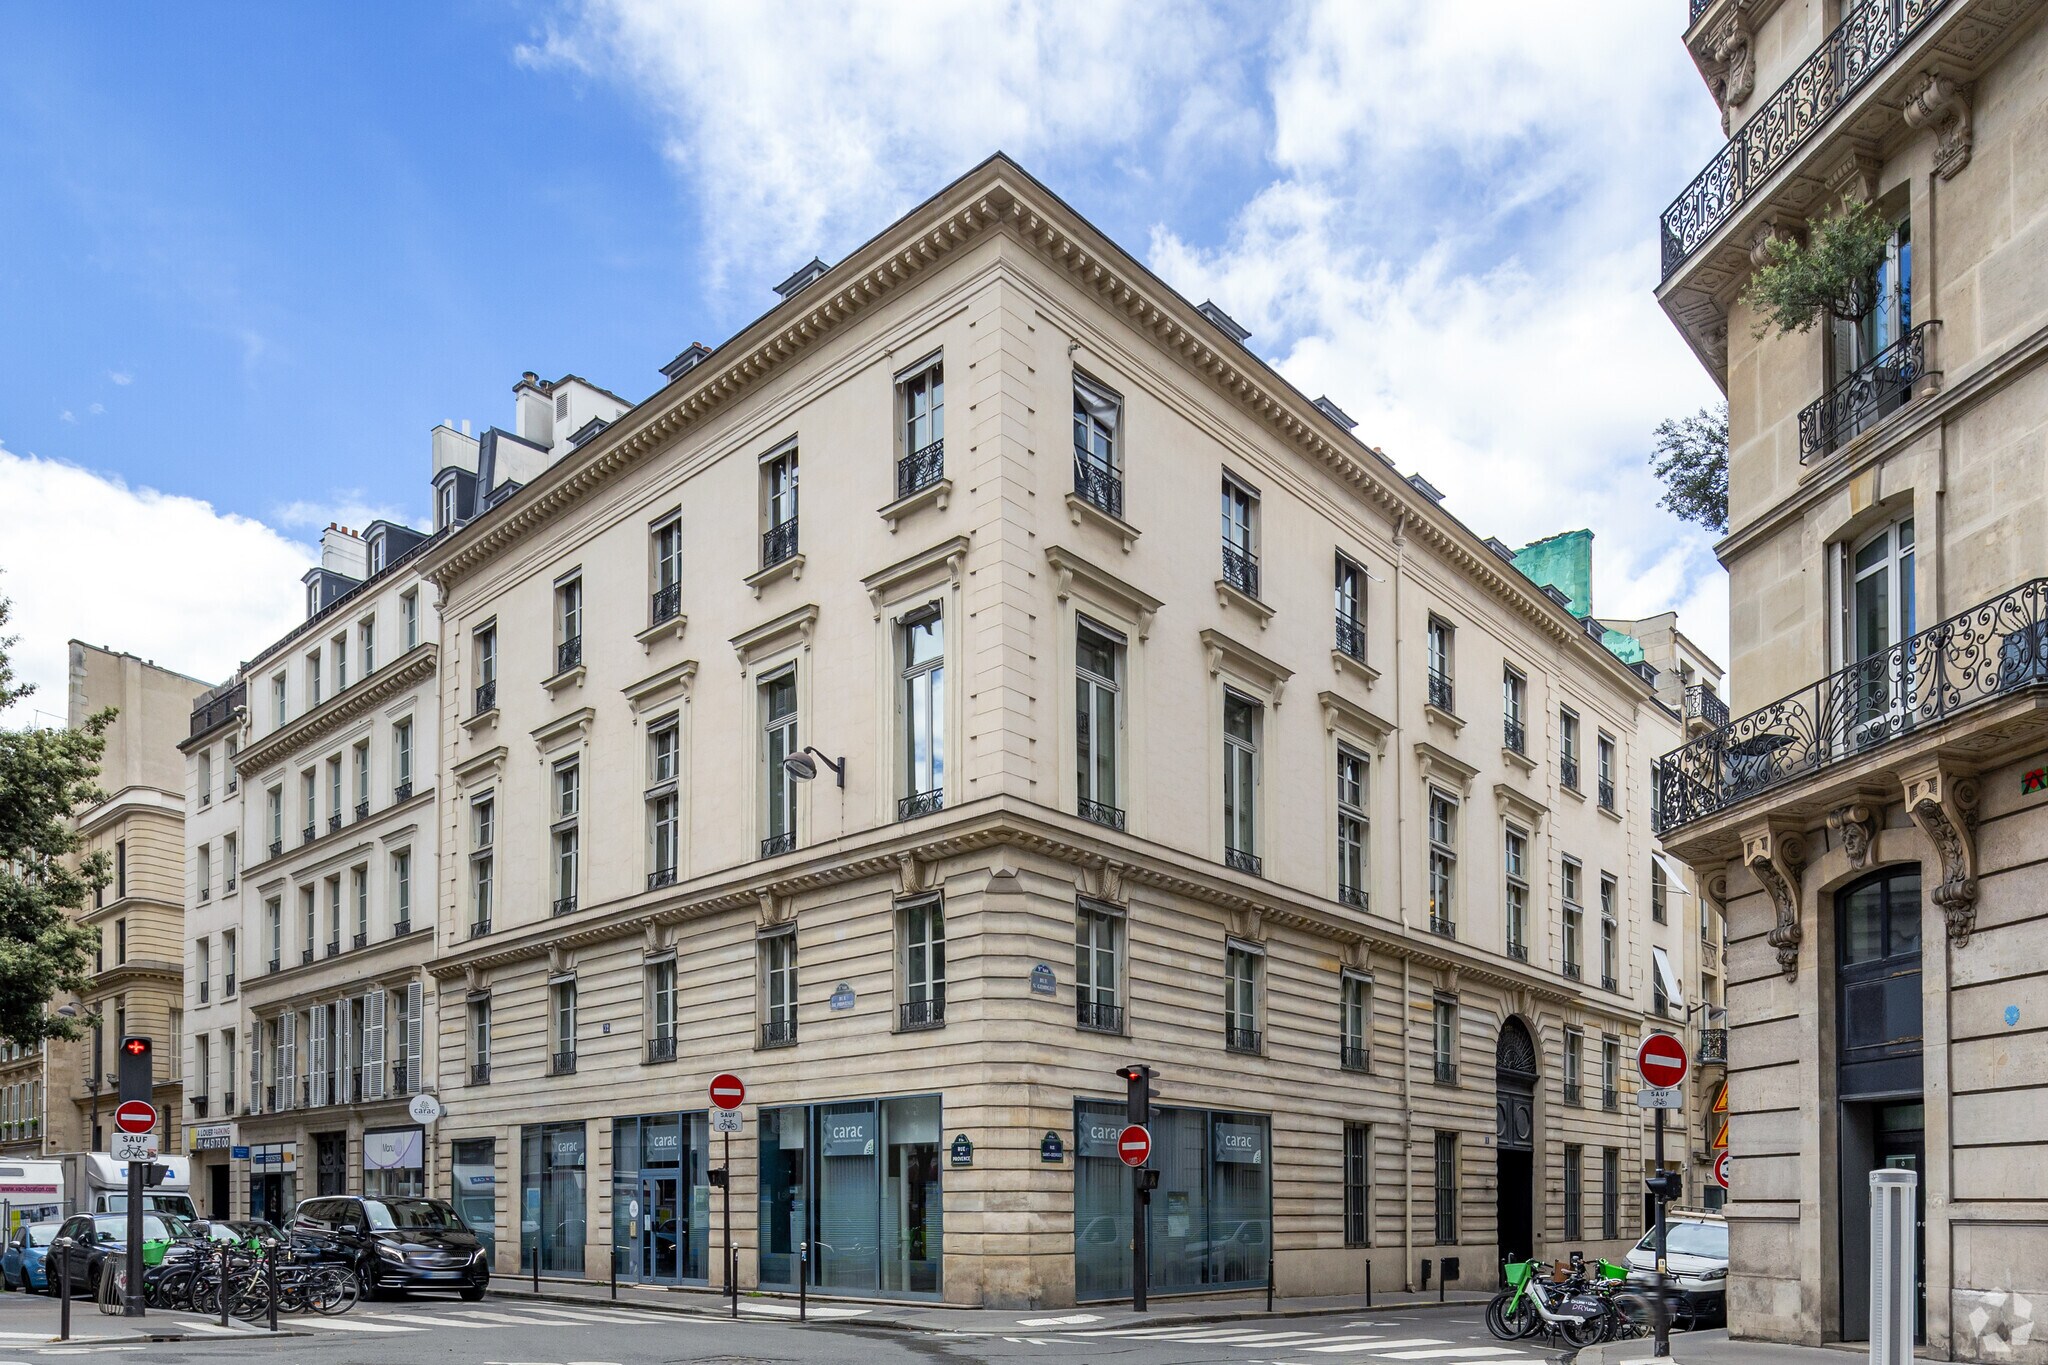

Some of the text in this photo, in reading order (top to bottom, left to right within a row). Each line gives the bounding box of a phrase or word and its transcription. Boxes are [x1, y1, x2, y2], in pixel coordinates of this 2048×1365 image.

[200, 1128, 213, 1136] LOUER
[213, 1127, 230, 1135] PARKING
[833, 1125, 862, 1138] carac
[1091, 1126, 1123, 1139] carac
[122, 1135, 147, 1143] SAUF
[654, 1135, 677, 1147] carac
[1225, 1135, 1252, 1147] carac
[558, 1141, 577, 1152] carac
